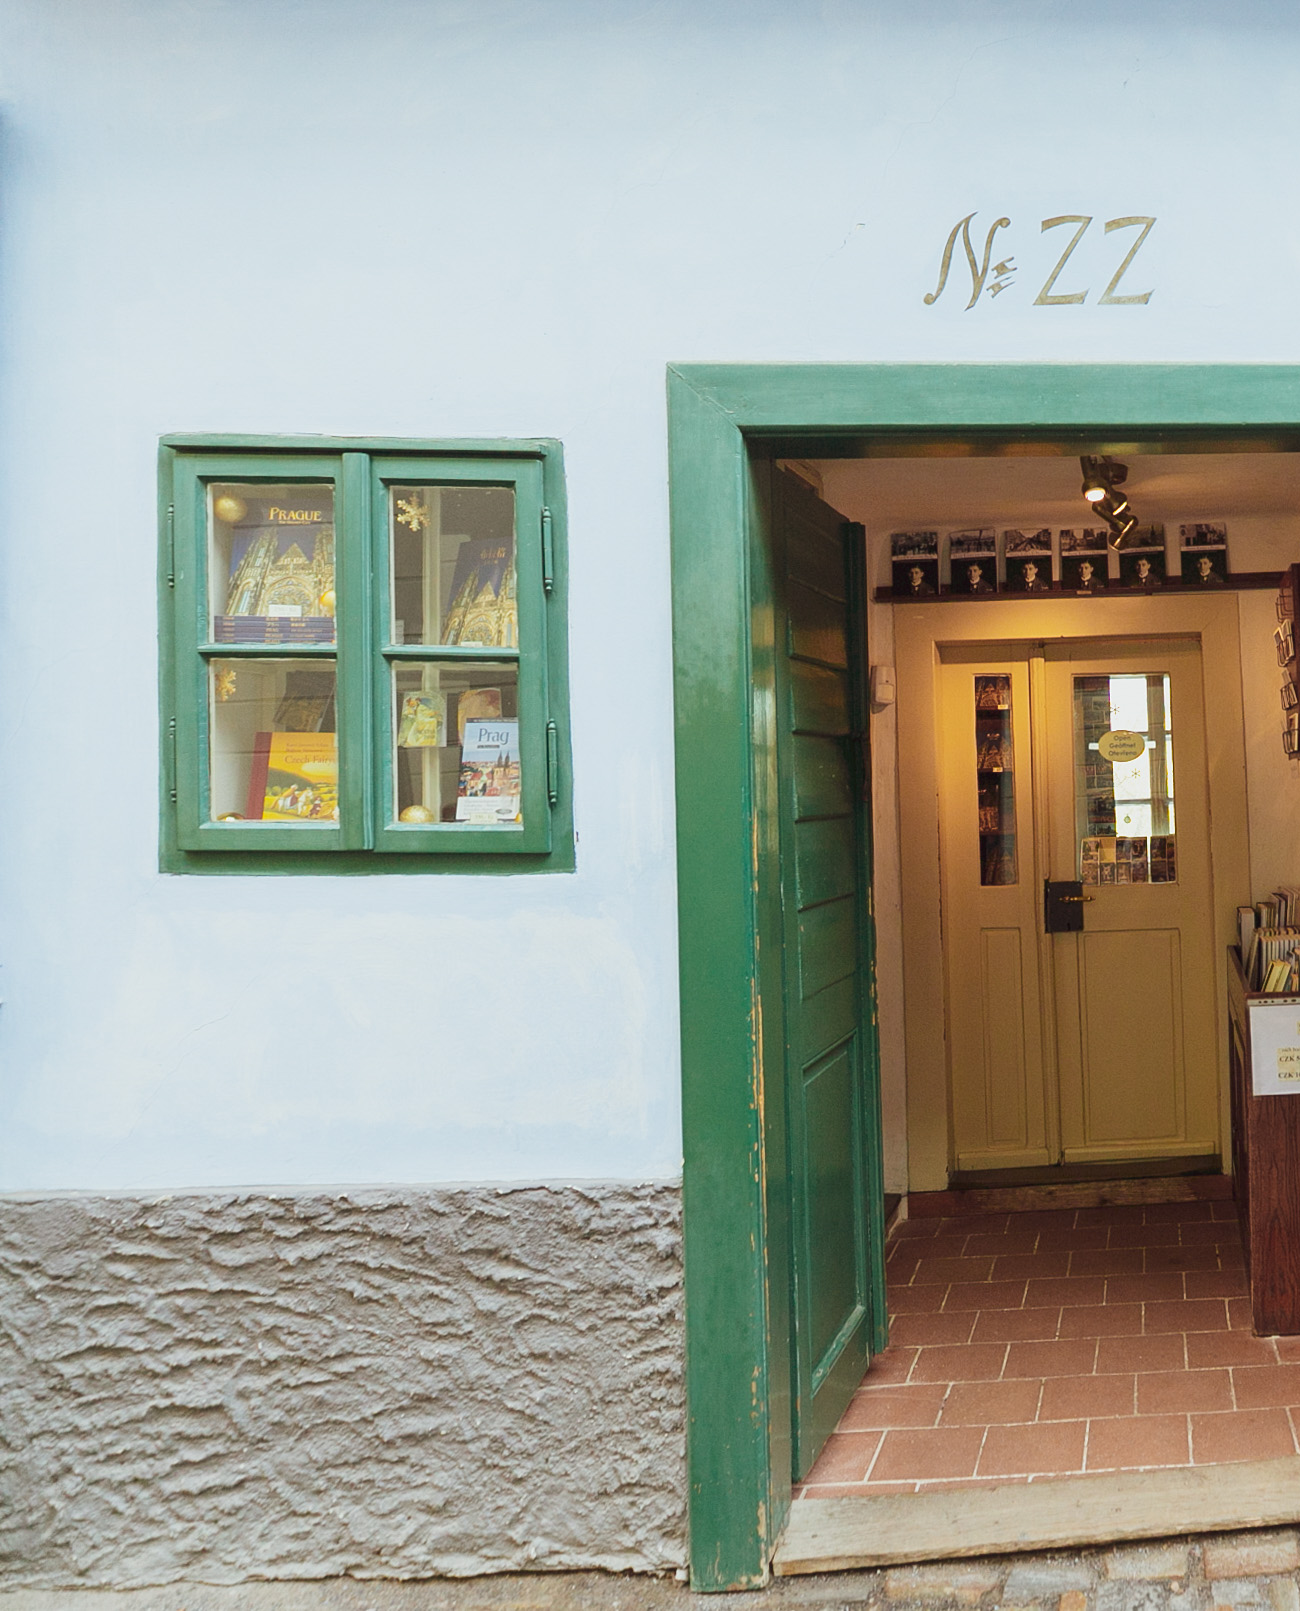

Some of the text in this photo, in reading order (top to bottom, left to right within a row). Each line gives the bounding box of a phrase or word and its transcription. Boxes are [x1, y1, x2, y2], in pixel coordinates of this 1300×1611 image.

[268, 506, 322, 521] PRAGUE
[478, 728, 510, 745] Prag
[284, 754, 310, 763] Czech
[1278, 1071, 1294, 1079] CZK
